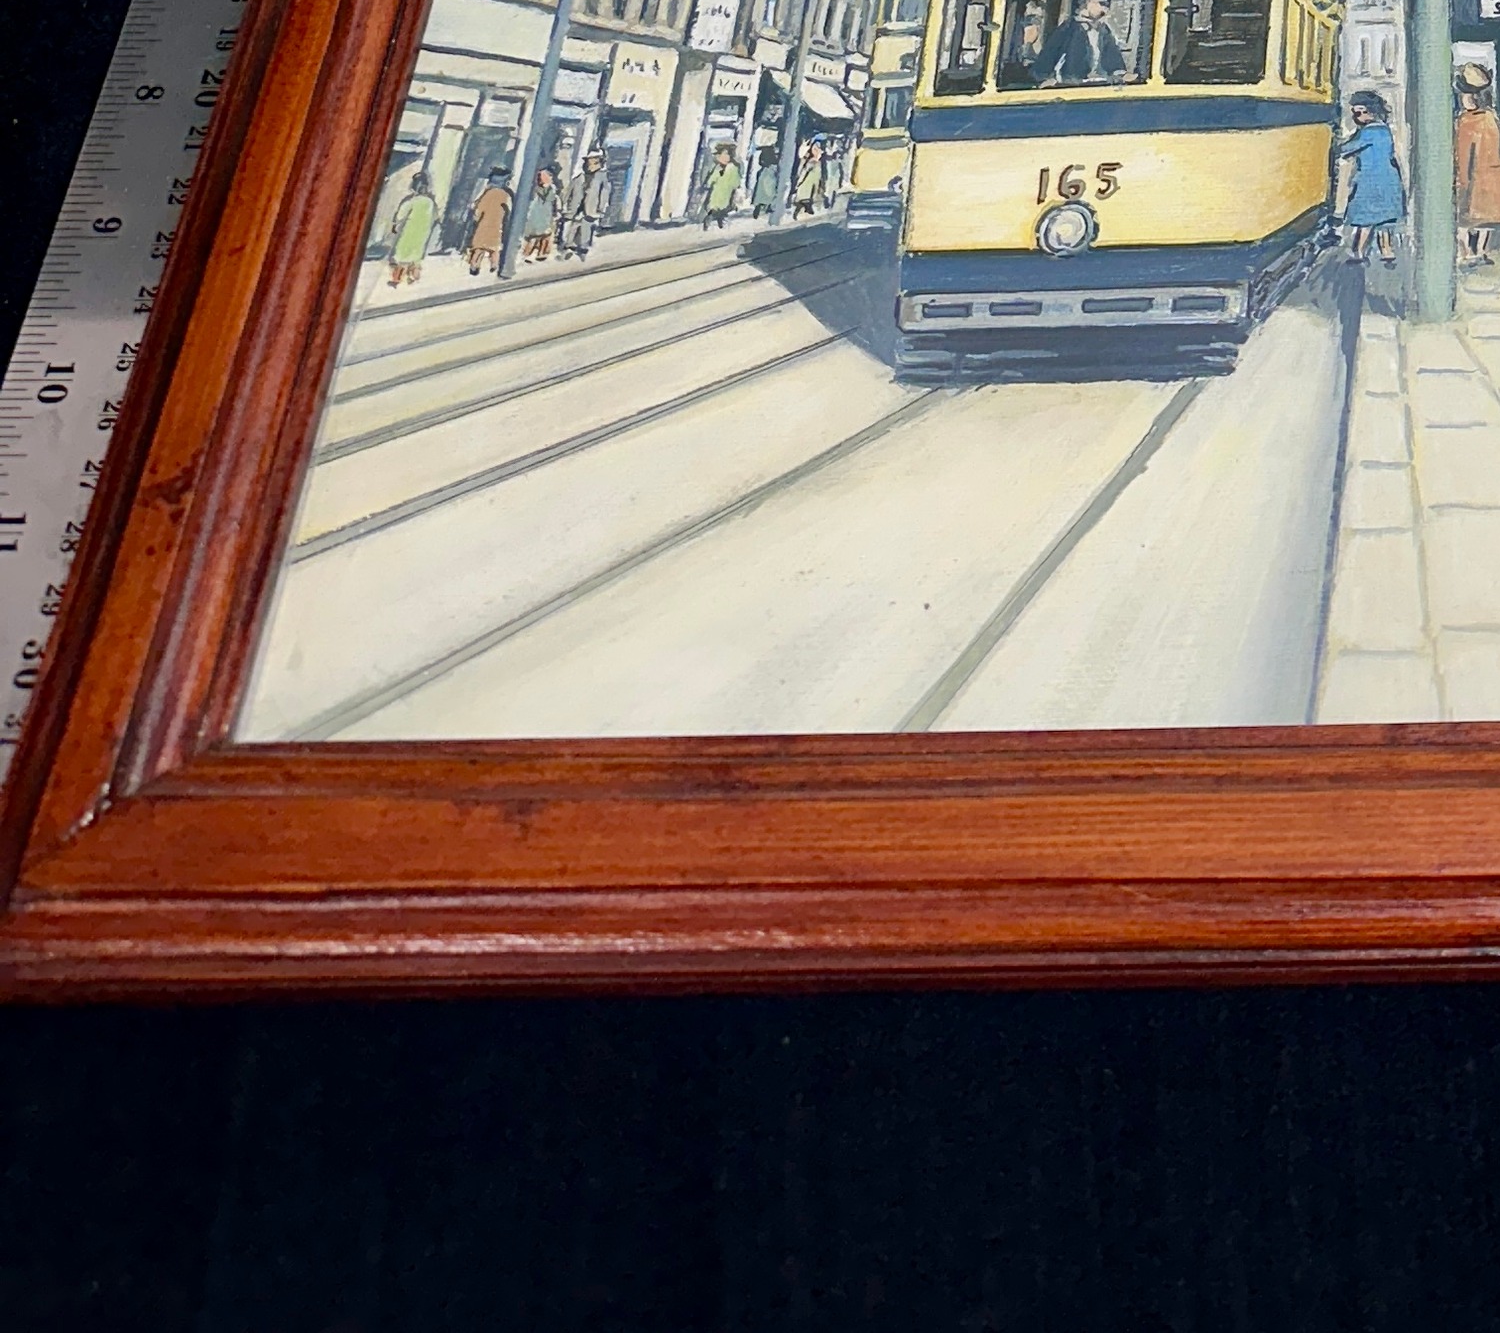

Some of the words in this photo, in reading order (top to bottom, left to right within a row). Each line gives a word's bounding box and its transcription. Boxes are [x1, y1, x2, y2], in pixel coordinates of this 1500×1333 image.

[215, 27, 239, 51] 19
[135, 85, 165, 101] 8
[194, 69, 227, 107] 20
[183, 126, 209, 151] 21
[167, 177, 193, 205] 22
[1036, 162, 1124, 205] 165
[92, 216, 123, 234] 9
[151, 231, 176, 259] 23
[133, 286, 160, 315] 24
[116, 342, 142, 372] 25
[37, 361, 76, 404] 10
[97, 400, 124, 430] 26
[80, 459, 105, 490] 27
[60, 520, 87, 553] 28
